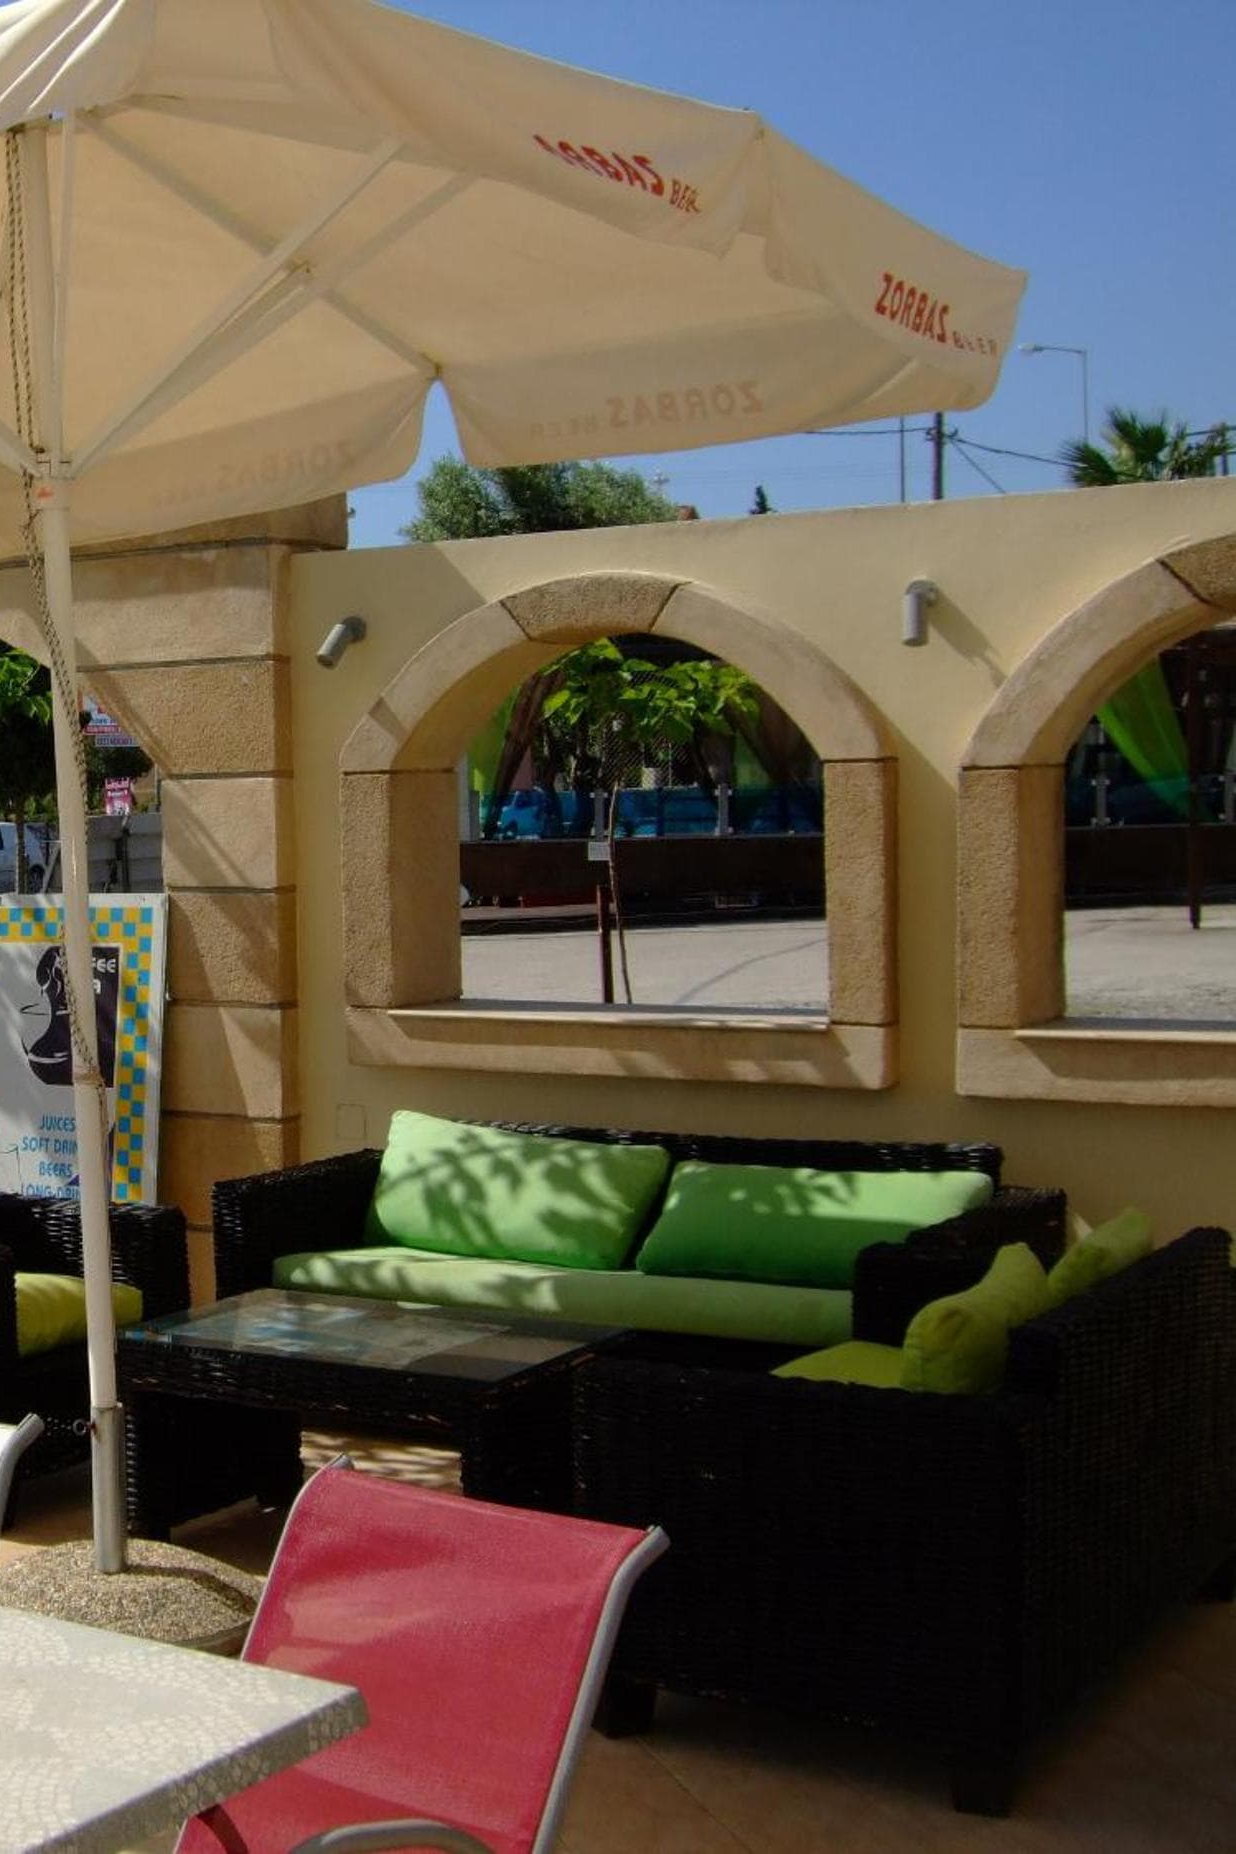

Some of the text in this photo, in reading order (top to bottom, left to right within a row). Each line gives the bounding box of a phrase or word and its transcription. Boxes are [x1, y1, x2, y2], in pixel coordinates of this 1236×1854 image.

[875, 271, 950, 343] ZORBAS
[39, 1114, 76, 1132] JUICES
[22, 1136, 50, 1152] SOFT
[38, 1161, 73, 1178] BEERS
